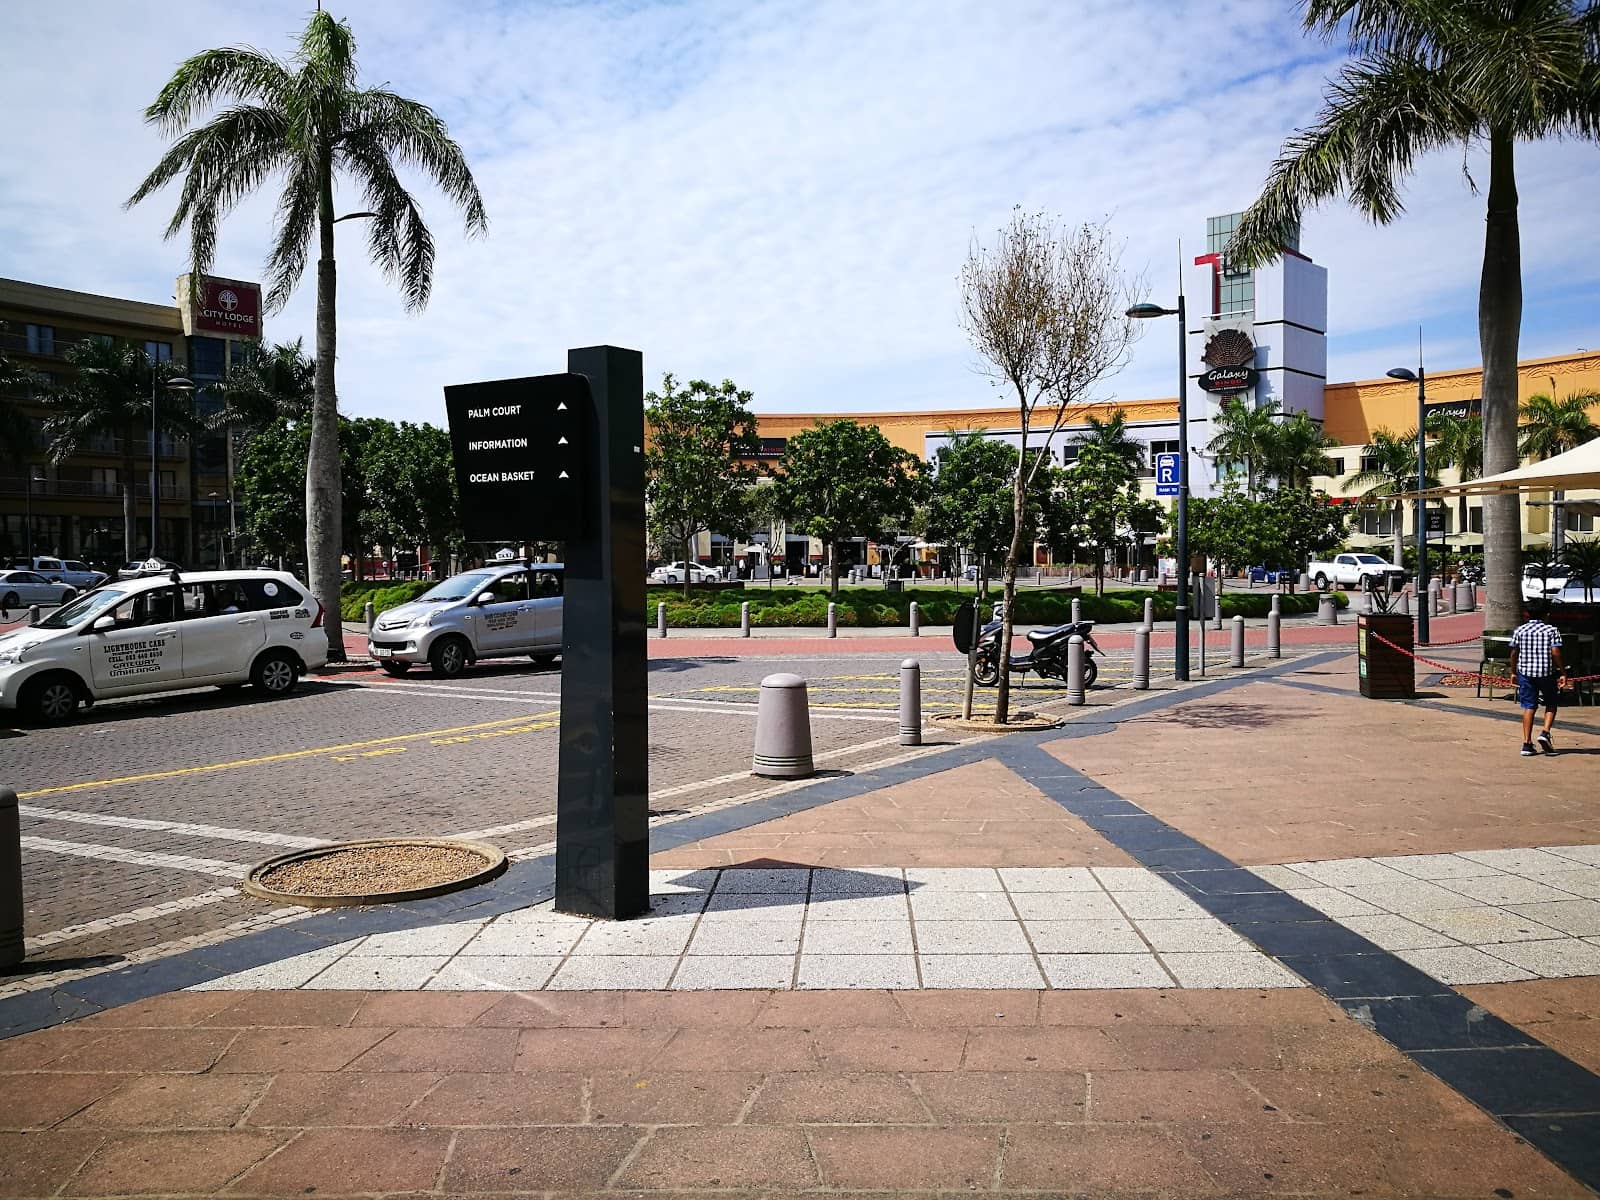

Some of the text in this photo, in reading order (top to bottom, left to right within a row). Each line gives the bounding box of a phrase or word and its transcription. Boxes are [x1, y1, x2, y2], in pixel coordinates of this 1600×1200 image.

[203, 309, 255, 324] CITY LODGE
[215, 320, 242, 329] HOTEL
[1208, 369, 1249, 381] Galaxy
[468, 405, 522, 419] PALM COURT
[468, 438, 528, 451] INFORMATION
[469, 471, 535, 483] OCEAN BASKET
[1162, 468, 1173, 482] R
[103, 641, 147, 654] LIGHTHOUSE
[149, 639, 165, 648] CABS
[112, 659, 155, 670] GATEWAY
